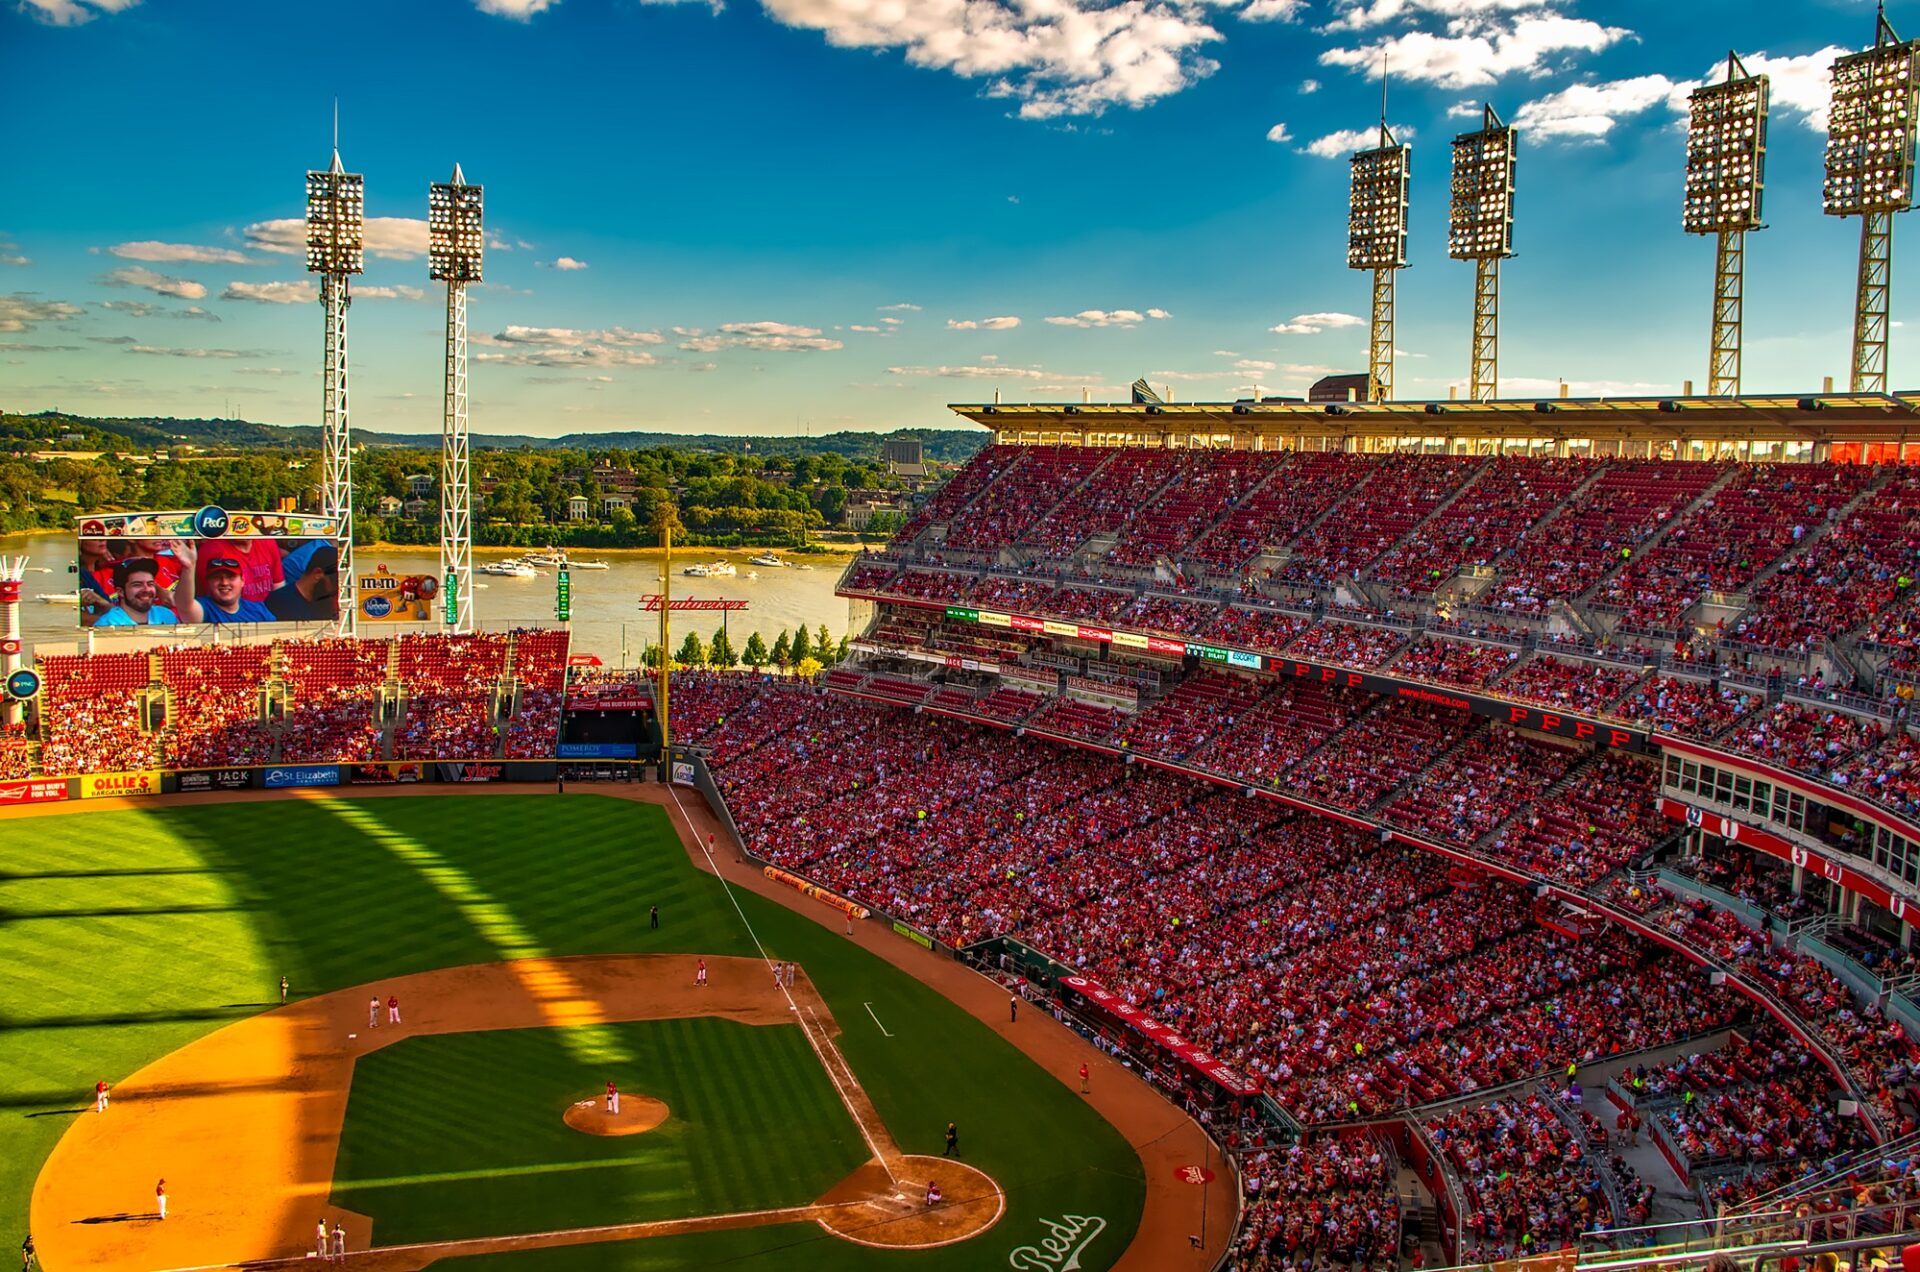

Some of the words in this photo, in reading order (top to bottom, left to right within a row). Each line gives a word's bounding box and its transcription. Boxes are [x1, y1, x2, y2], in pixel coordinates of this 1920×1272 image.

[202, 517, 226, 528] P&G
[232, 520, 249, 532] Tide
[946, 658, 960, 667] JACK
[1058, 656, 1075, 666] JACK
[1001, 664, 1018, 674] JACK
[1068, 678, 1086, 687] JACK
[1117, 688, 1137, 697] CASINO
[1398, 687, 1470, 709] www.formica.com
[217, 771, 248, 781] JACK
[296, 770, 337, 780] Elizabeth
[48, 782, 66, 790] BUD'S
[92, 789, 123, 797] BARGAIN
[1009, 1214, 1107, 1272] Reds
